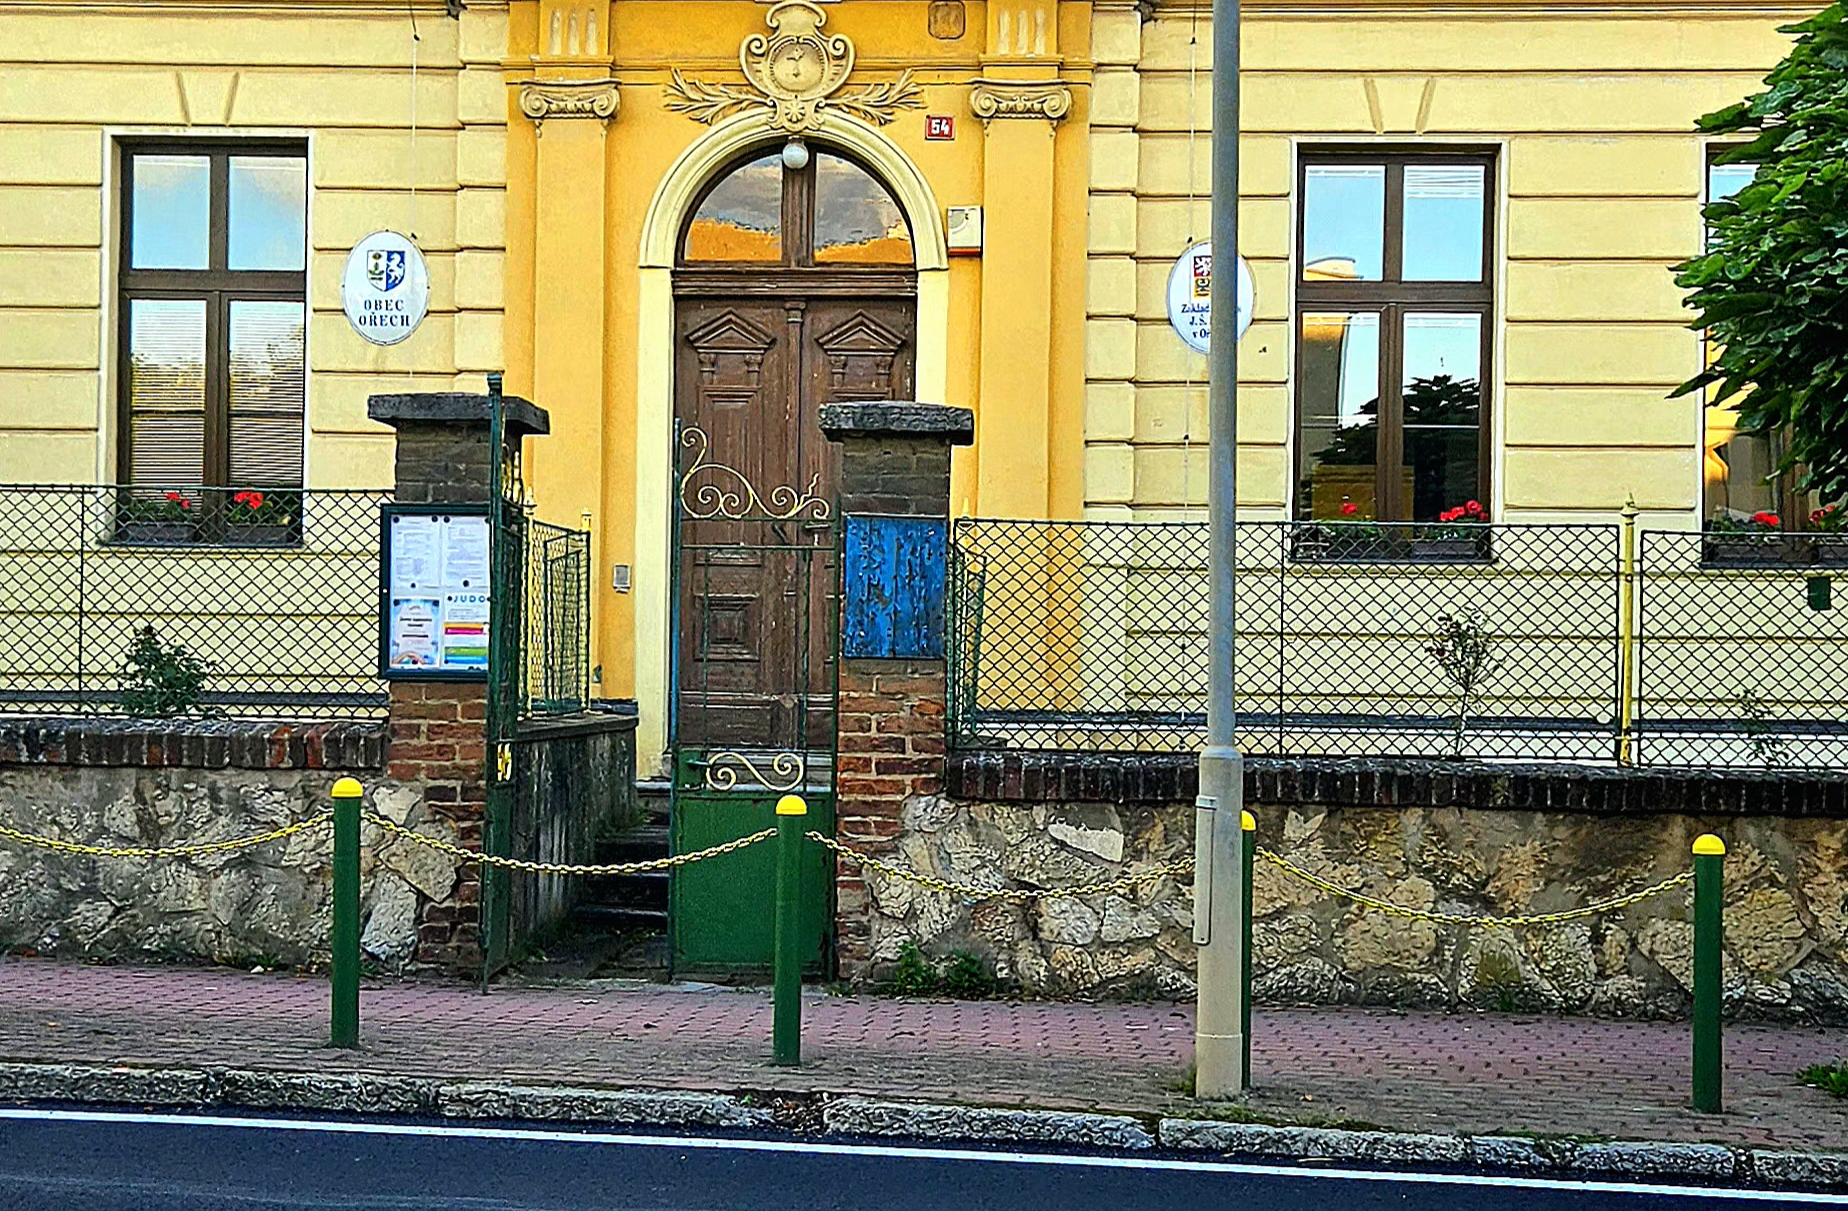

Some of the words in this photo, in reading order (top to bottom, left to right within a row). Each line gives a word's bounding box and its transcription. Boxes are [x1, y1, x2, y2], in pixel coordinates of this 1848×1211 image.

[931, 118, 951, 136] 54
[363, 299, 405, 312] OBEC
[358, 312, 410, 327] OŘECH
[453, 595, 486, 604] JUDO
